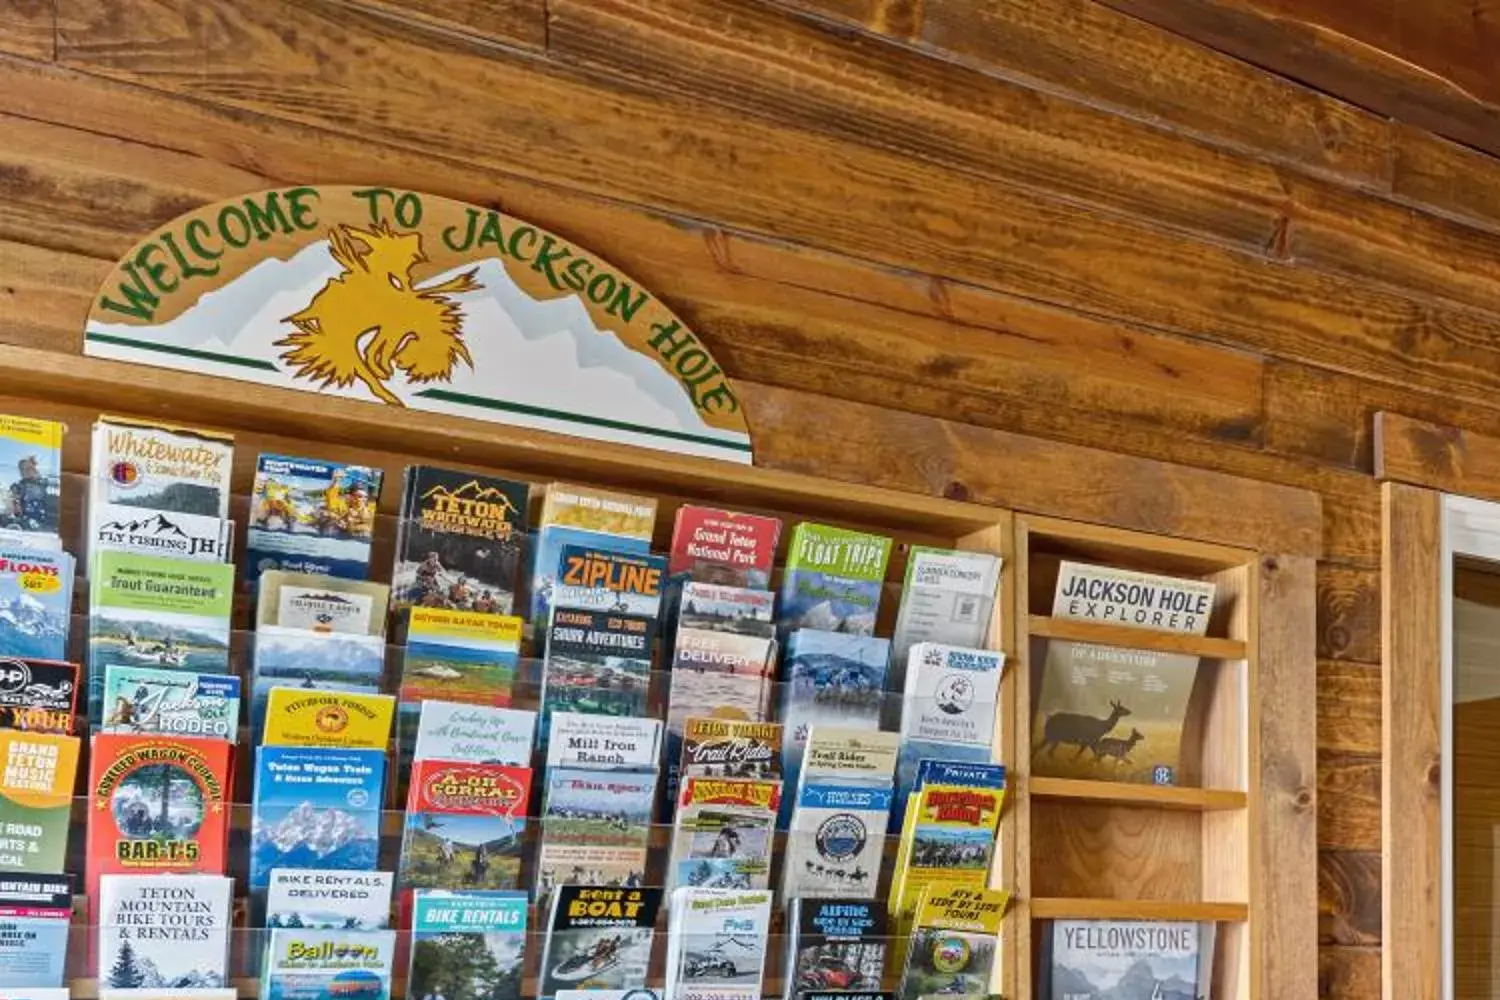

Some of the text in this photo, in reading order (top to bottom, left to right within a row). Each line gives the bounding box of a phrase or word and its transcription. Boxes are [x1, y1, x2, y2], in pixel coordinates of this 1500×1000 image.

[101, 186, 739, 416] WELCOME TO JACKSON HOLE
[108, 430, 225, 467] Whitewater
[433, 495, 506, 521] TETON
[98, 530, 216, 555] FLY FISHING JH
[694, 527, 726, 544] Grand
[800, 539, 883, 568] FLOAT TRIPS
[564, 556, 661, 597] ZIPLINE
[1063, 576, 1208, 615] JACKSON HOLE
[1069, 600, 1195, 629] EXPLORER
[568, 738, 636, 751] Mill Iron
[137, 747, 187, 762] WAGON
[944, 768, 988, 780] PRIVATE
[6, 823, 42, 837] ROAD
[278, 874, 313, 885] BIKE
[139, 887, 195, 899] TETON
[287, 889, 369, 899] DELIVERED
[119, 900, 211, 914] MOUNTAIN
[568, 900, 644, 918] BOAT
[116, 914, 215, 927] BIKE TOURS
[426, 909, 520, 925] BIKE RENTALS
[119, 927, 210, 940] & RENTALS
[1064, 927, 1191, 951] YELLOWSTONE
[287, 939, 379, 961] Balloon
